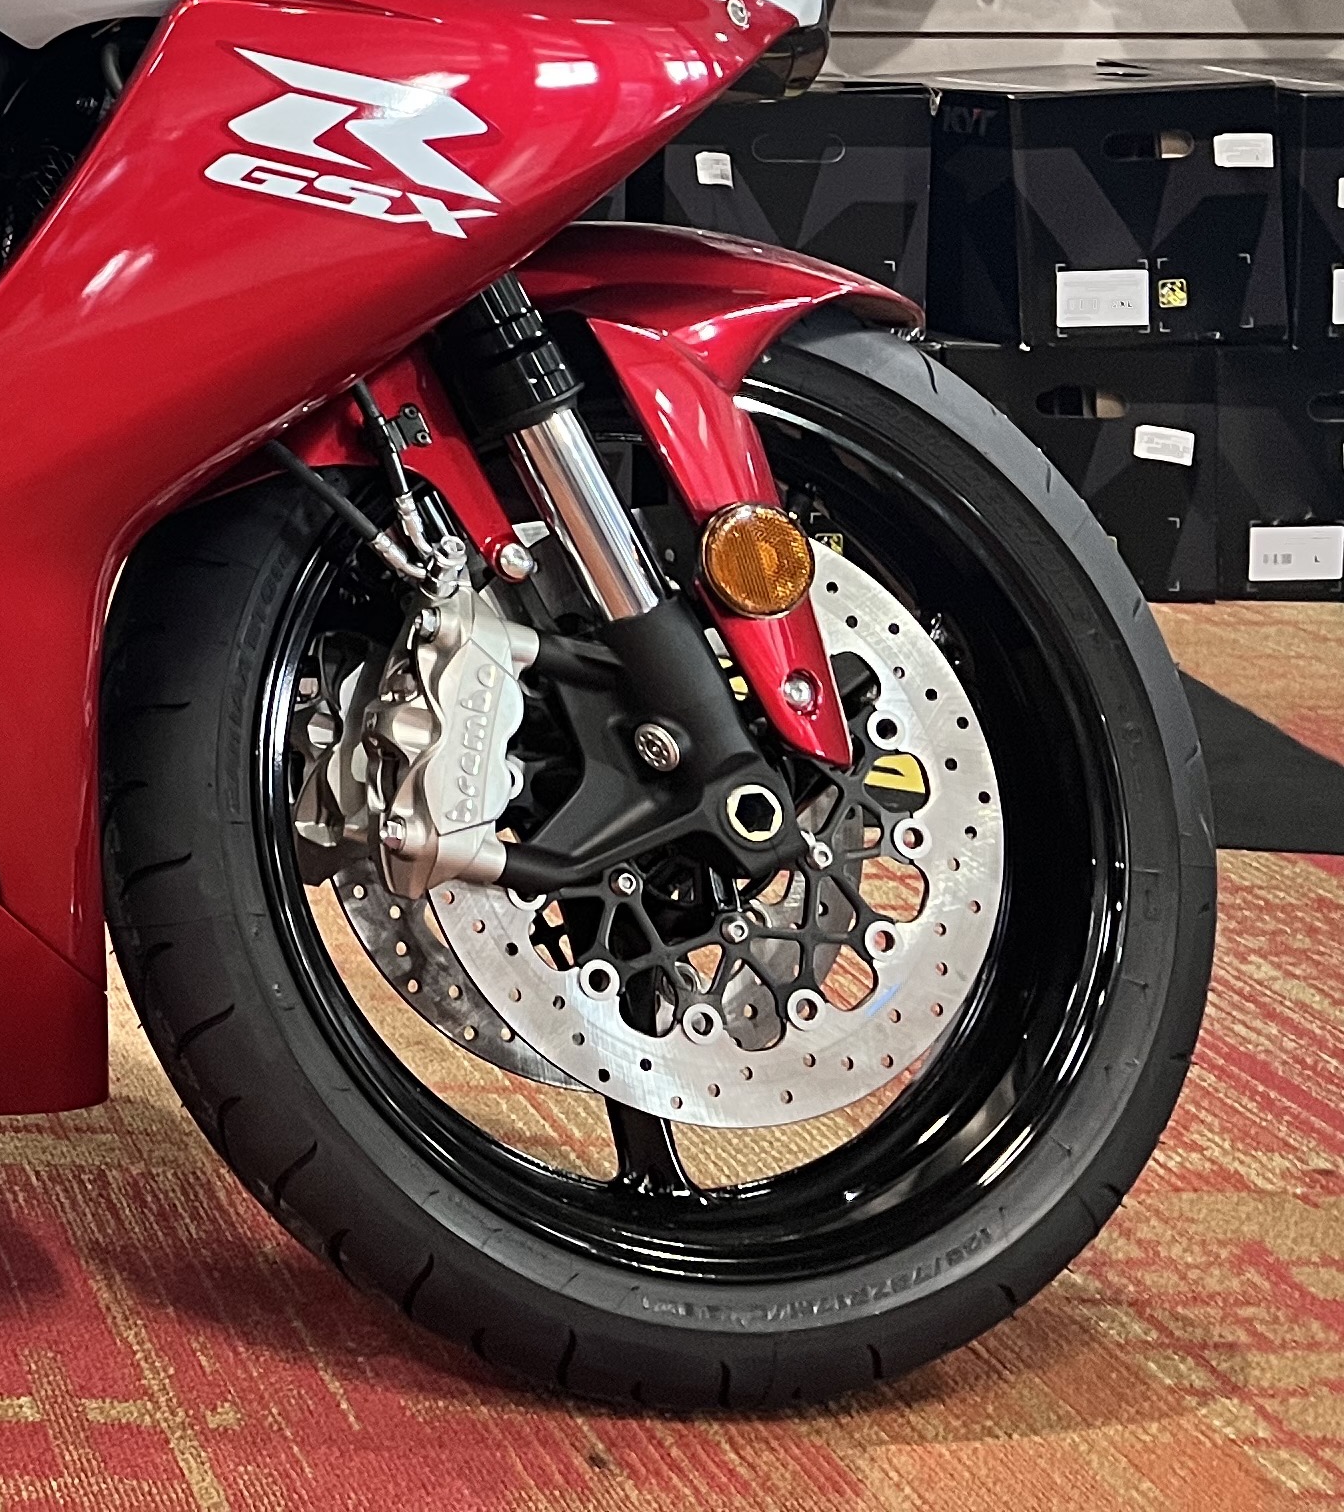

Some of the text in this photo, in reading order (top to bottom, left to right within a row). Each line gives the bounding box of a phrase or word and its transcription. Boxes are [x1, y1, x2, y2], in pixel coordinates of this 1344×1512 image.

[204, 152, 500, 240] GSX
[228, 45, 504, 206] R
[445, 663, 498, 824] brembo
